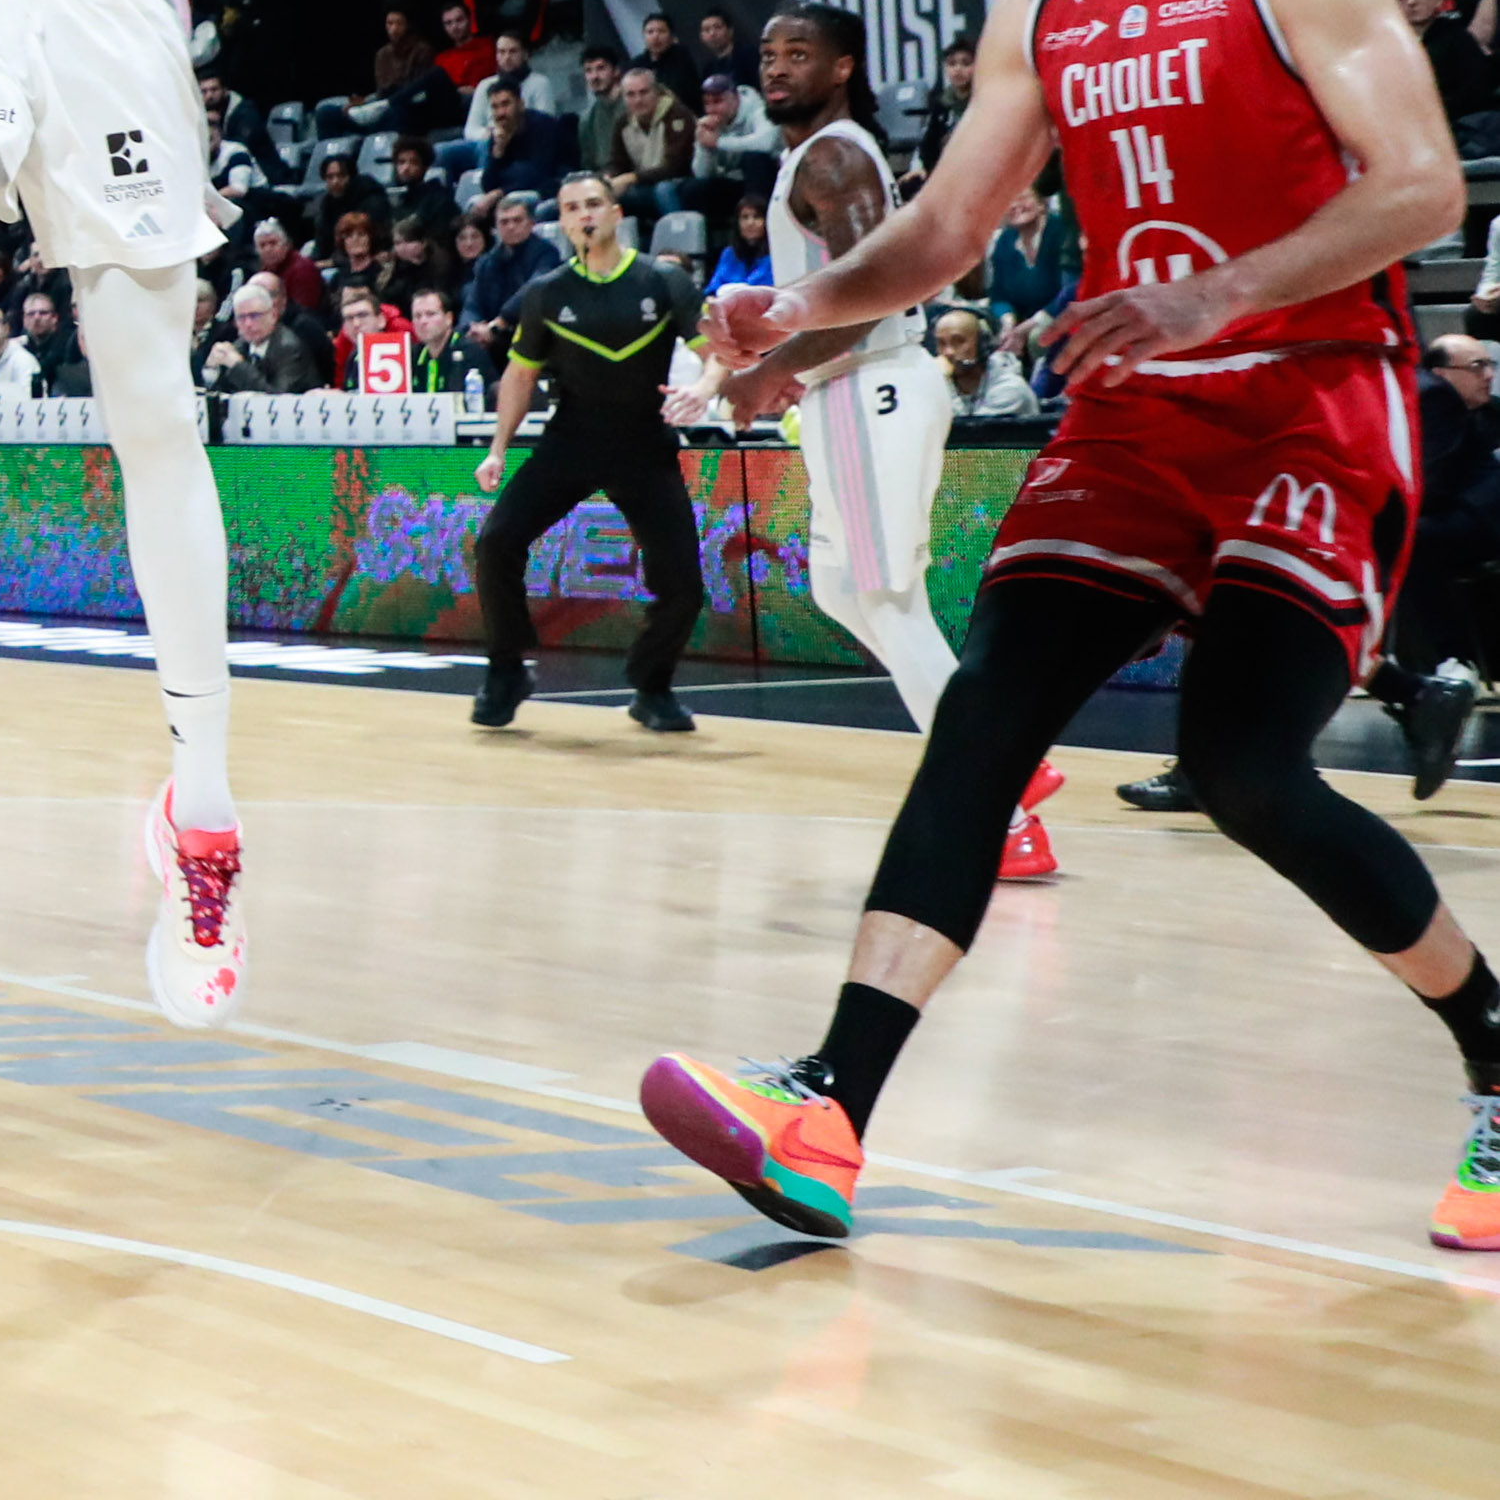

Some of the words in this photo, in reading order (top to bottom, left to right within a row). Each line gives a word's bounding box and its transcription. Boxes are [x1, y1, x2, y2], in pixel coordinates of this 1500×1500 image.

[1060, 38, 1208, 130] CHOLET
[1109, 125, 1175, 210] 14
[366, 341, 405, 392] 5
[875, 384, 898, 415] 3
